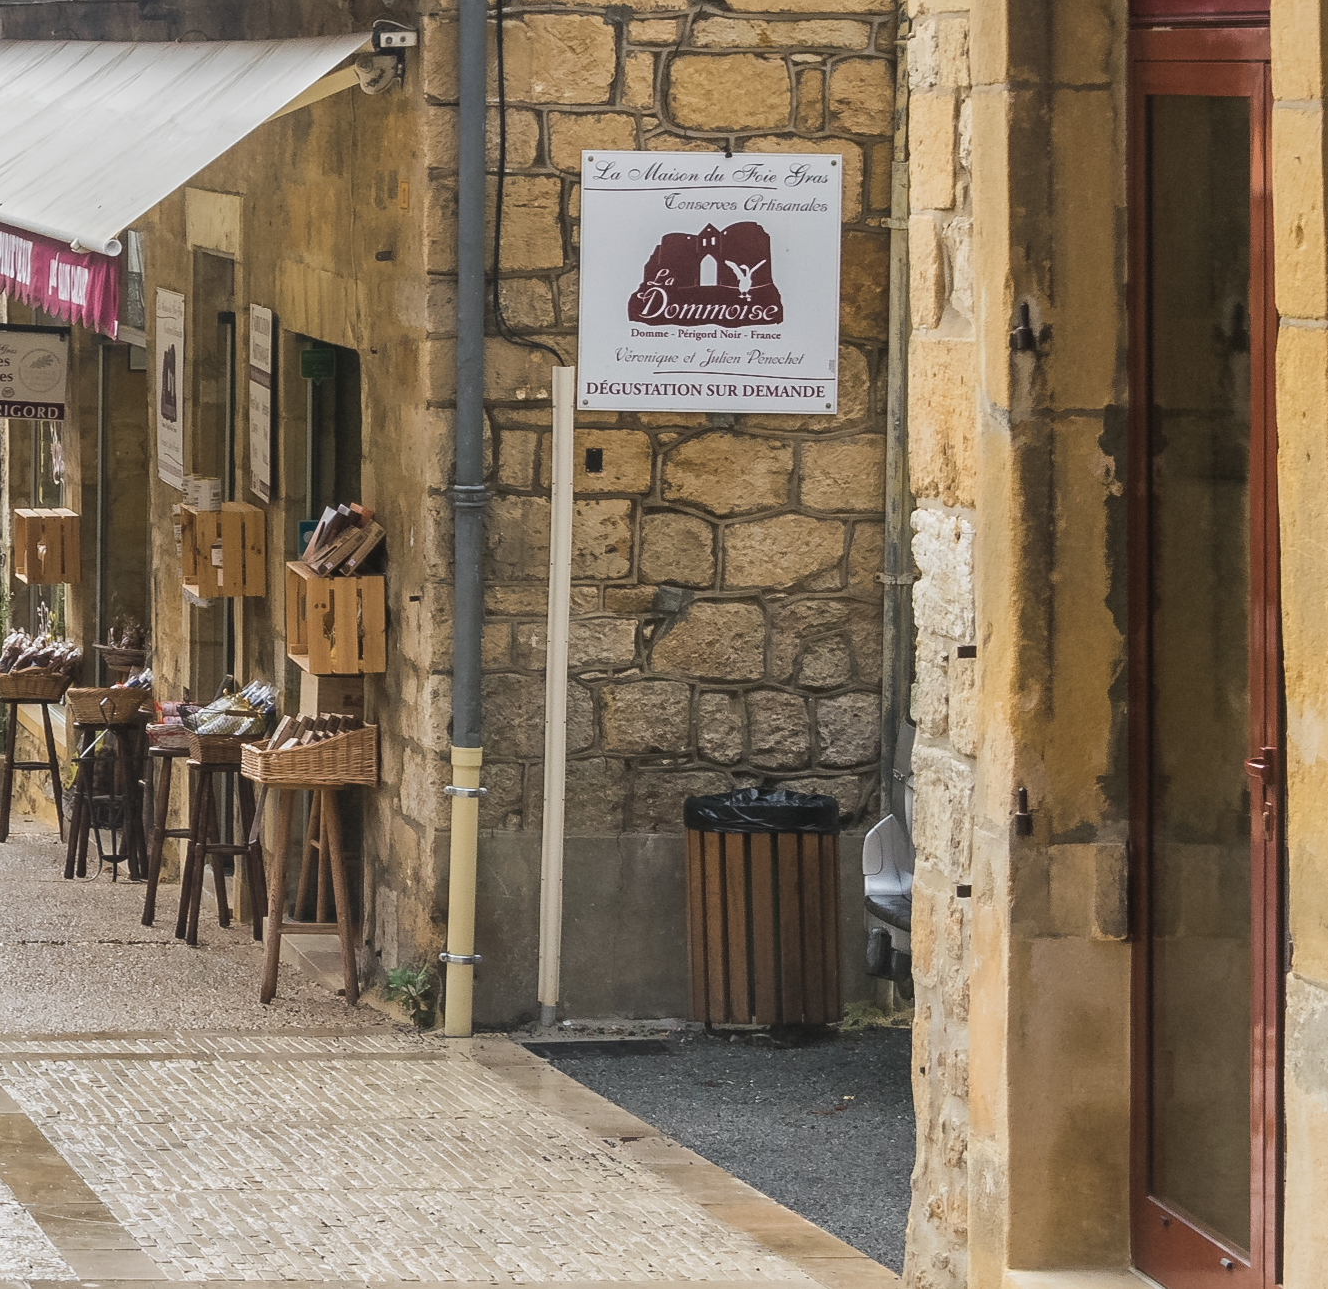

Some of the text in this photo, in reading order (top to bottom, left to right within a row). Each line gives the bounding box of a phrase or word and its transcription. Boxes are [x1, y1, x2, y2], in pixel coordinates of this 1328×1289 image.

[592, 160, 829, 187] La Maison du Foie Gras
[664, 192, 828, 212] Conserves Artisanales
[636, 268, 779, 321] La Dommoise
[631, 328, 669, 338] Domme
[677, 329, 717, 341] Périgord
[720, 330, 742, 339] Noir
[750, 331, 781, 340] France
[614, 347, 679, 367] Véronique
[683, 352, 696, 362] et
[699, 348, 741, 367] Julien
[586, 380, 826, 398] DÉGUSTATION SUR DEMANDE
